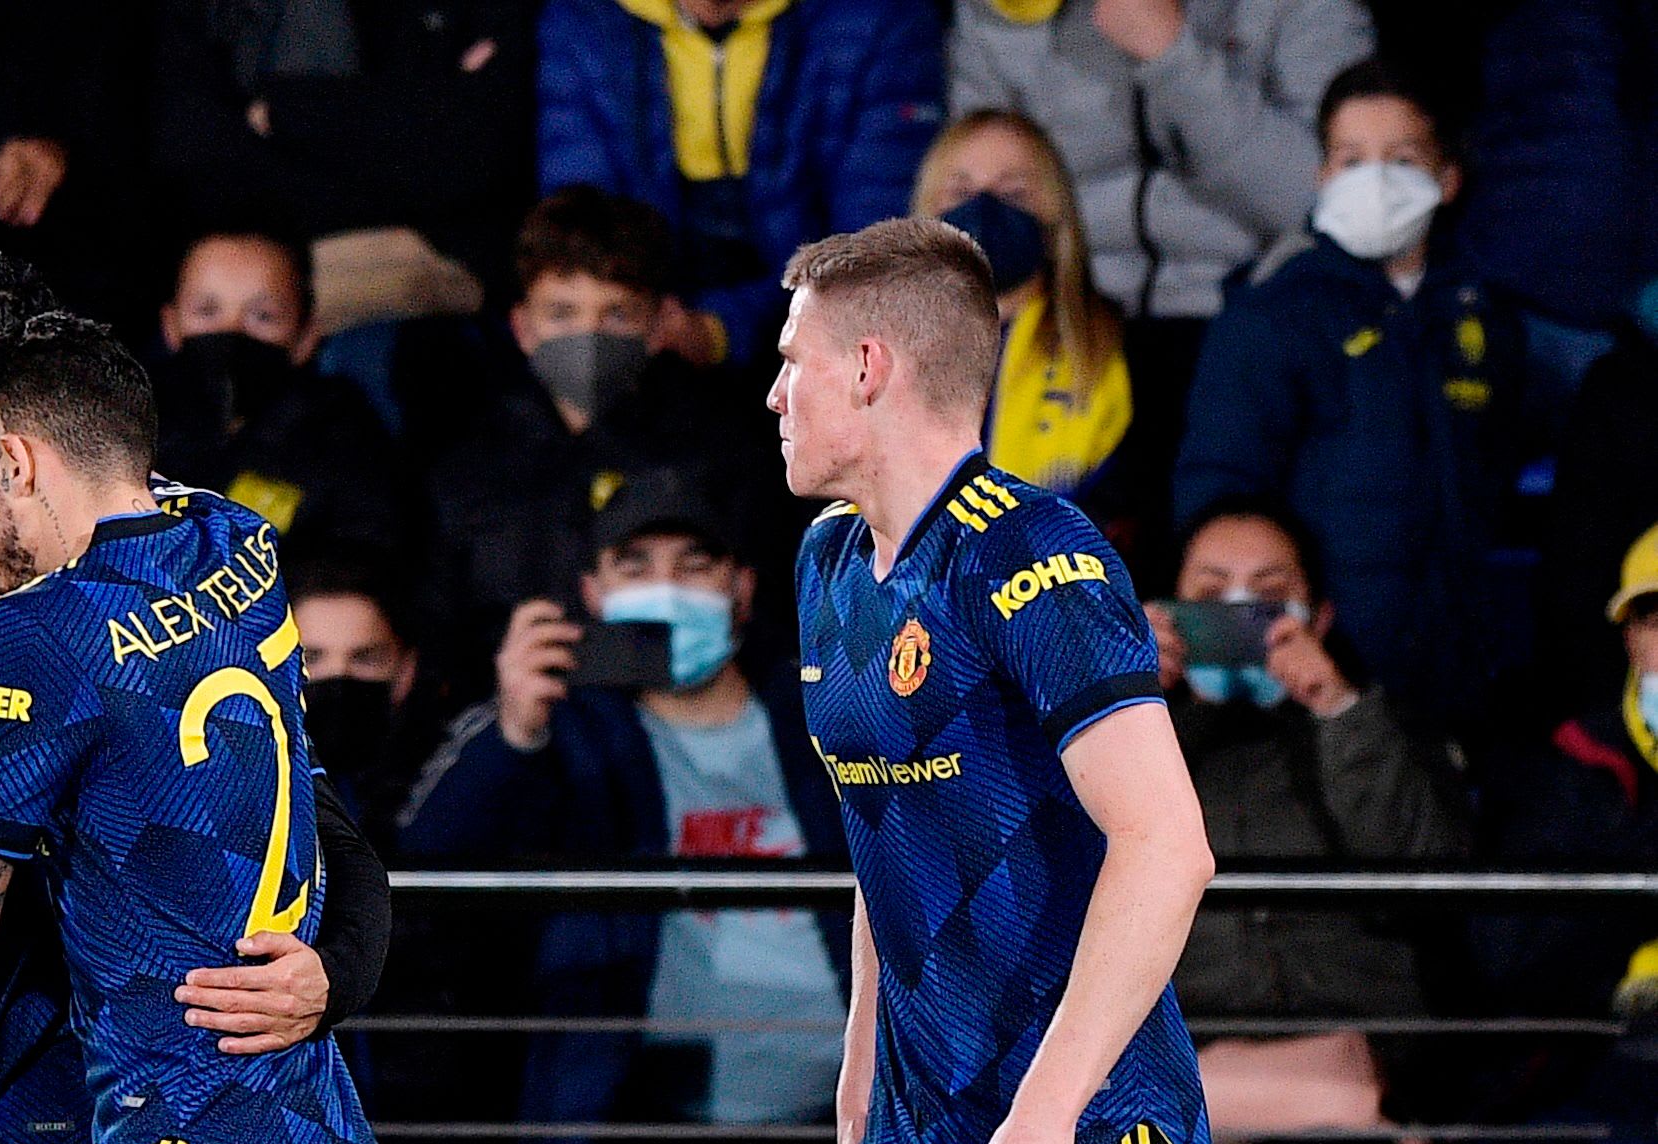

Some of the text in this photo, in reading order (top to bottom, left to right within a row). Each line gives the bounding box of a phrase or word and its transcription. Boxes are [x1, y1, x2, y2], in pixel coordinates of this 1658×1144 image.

[108, 522, 278, 666] ALEX TELLES
[990, 552, 1111, 621] KOHLER
[826, 752, 963, 785] TeamViewer
